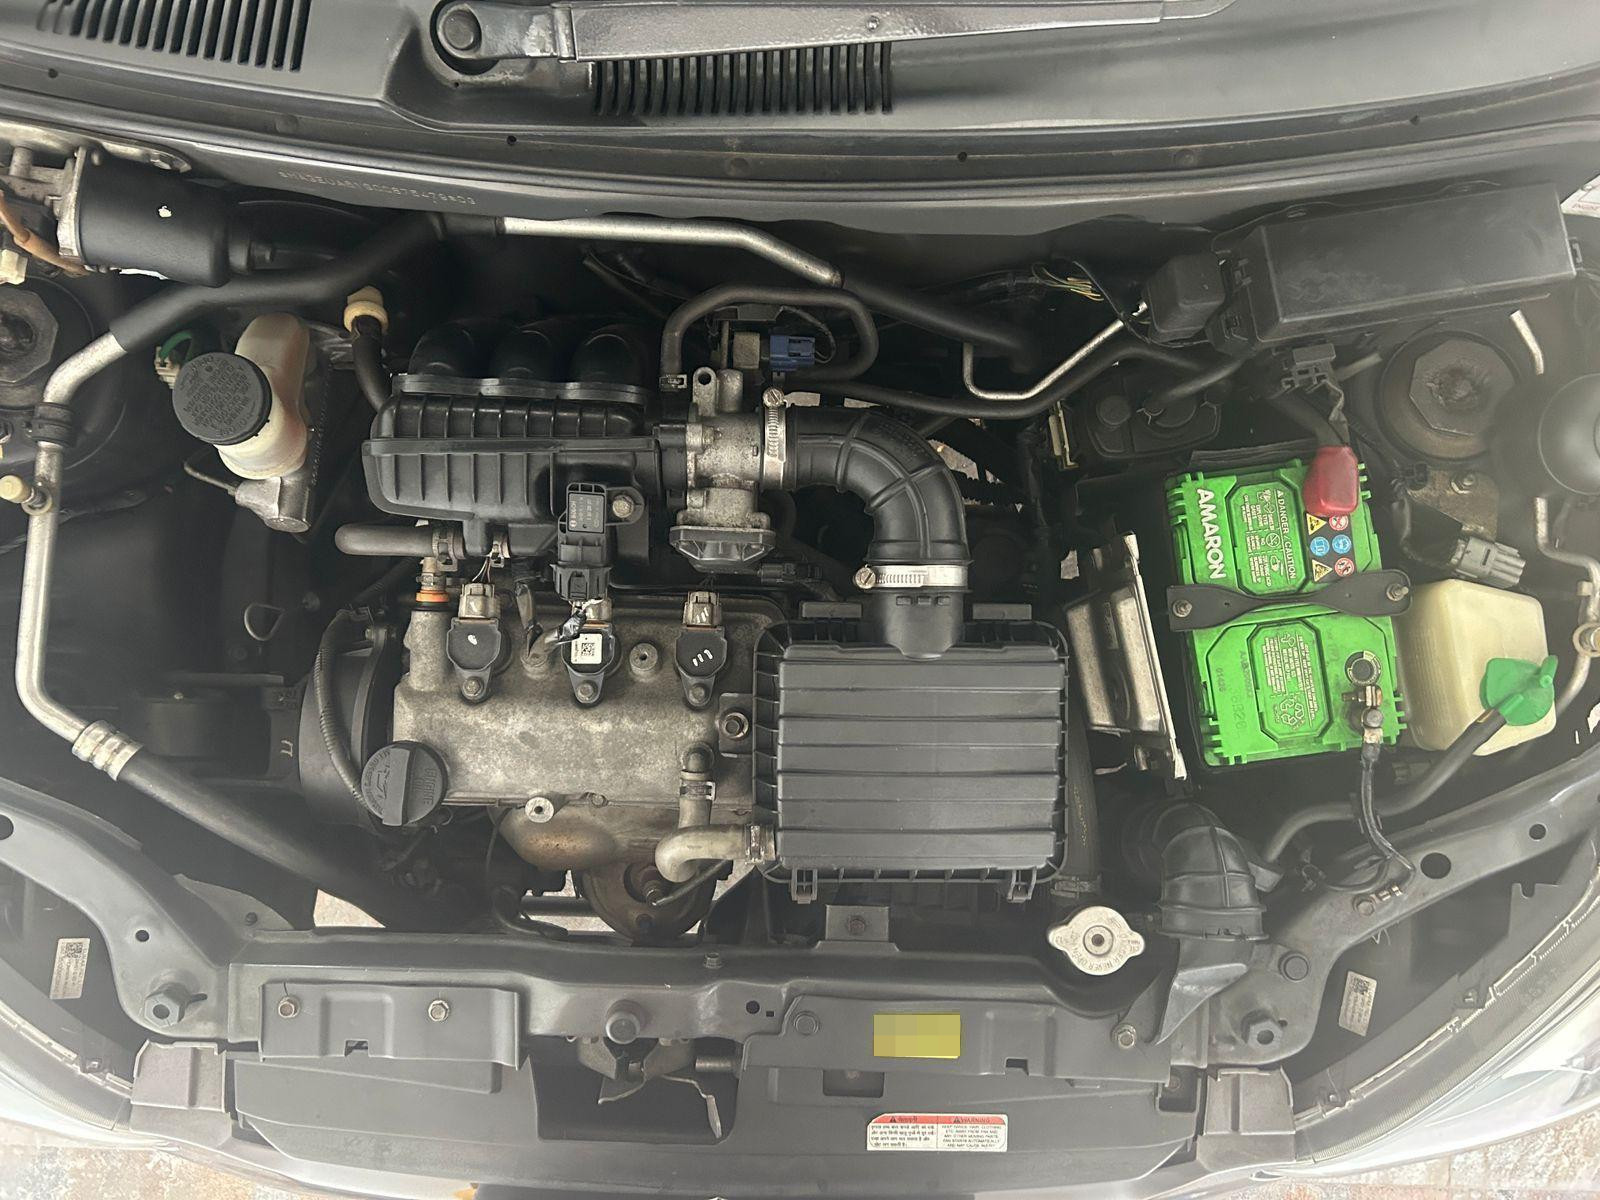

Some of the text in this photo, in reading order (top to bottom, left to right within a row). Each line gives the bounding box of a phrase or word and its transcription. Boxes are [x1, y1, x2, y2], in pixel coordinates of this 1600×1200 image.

[1197, 489, 1226, 579] AMARON
[1278, 499, 1289, 533] DANGER
[1285, 542, 1296, 578] CAUTION
